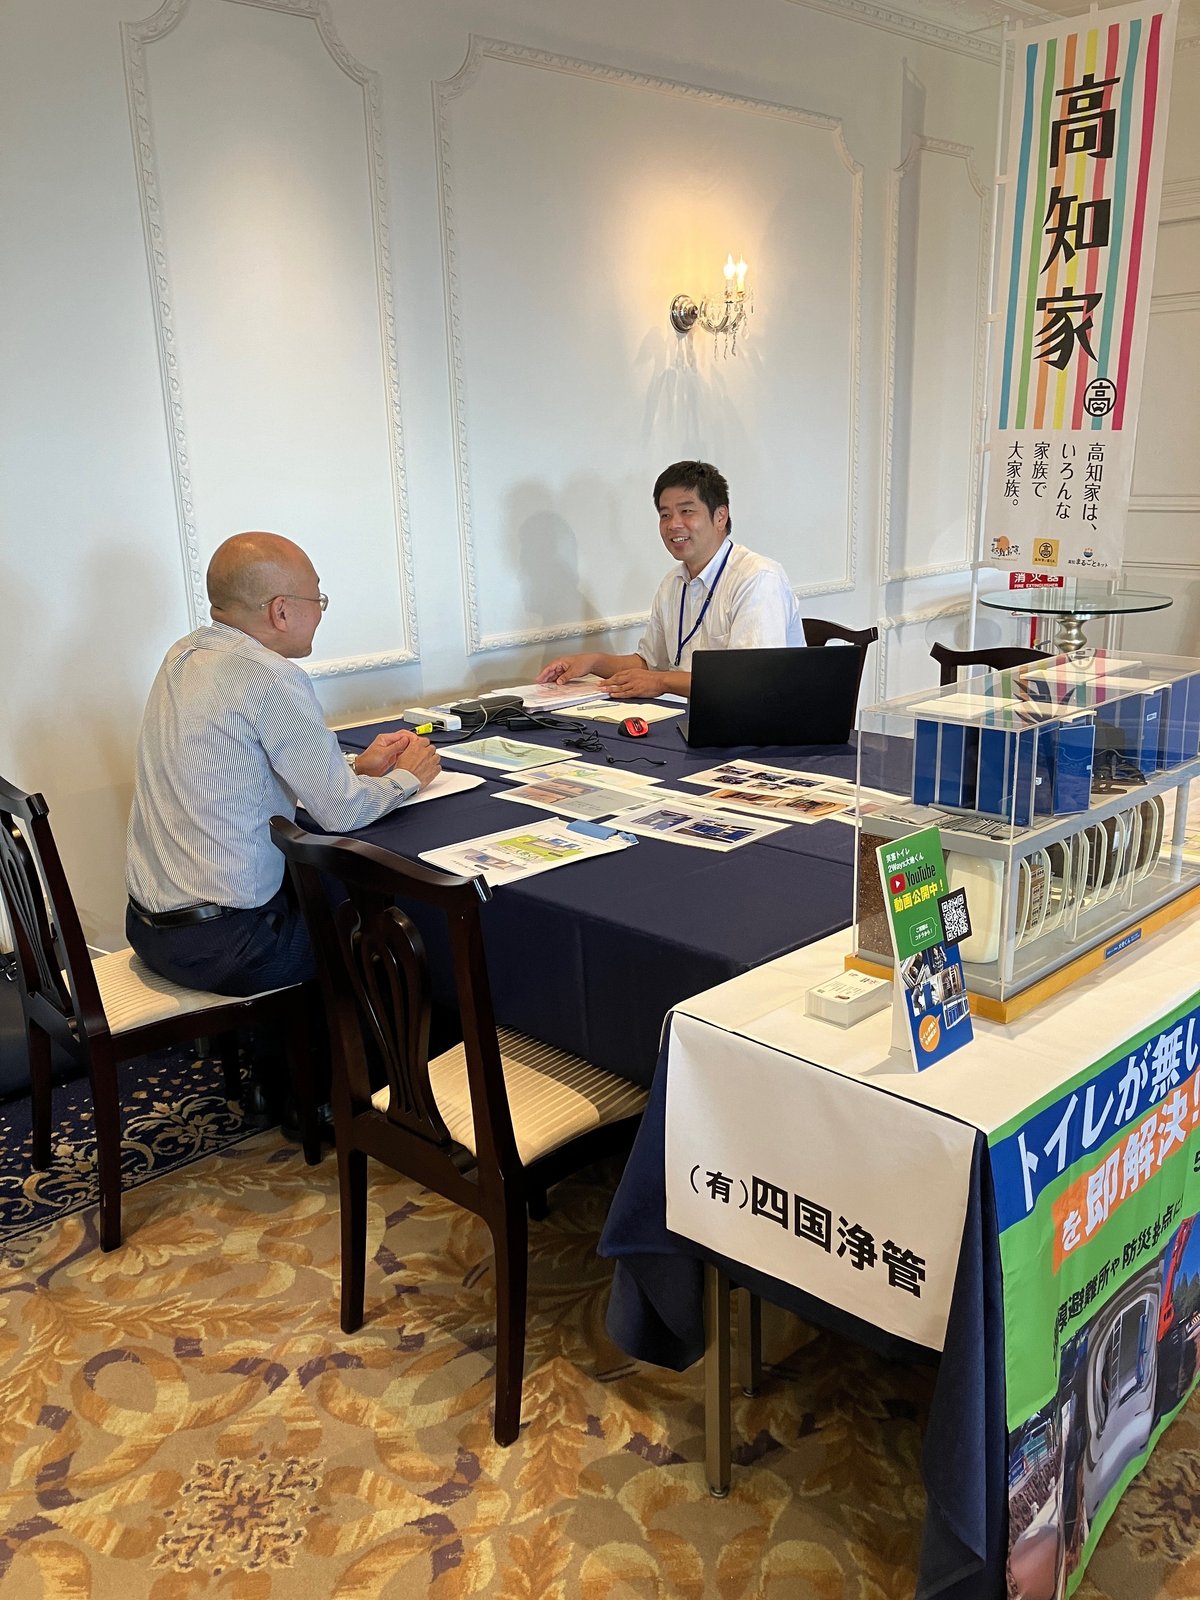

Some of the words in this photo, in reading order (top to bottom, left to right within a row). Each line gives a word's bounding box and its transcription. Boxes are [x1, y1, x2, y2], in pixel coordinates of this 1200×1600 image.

[1033, 73, 1121, 371] 高知家
[1003, 440, 1025, 507] 大家族。
[1031, 440, 1050, 499] 家族で
[1055, 443, 1077, 519] いろんな
[1082, 442, 1106, 532] 高知家は、
[893, 879, 944, 913] 動画公開中！
[905, 863, 936, 887] YouTube
[1061, 1070, 1200, 1251] を即解決！
[690, 1164, 926, 1299] （有）四国浄管
